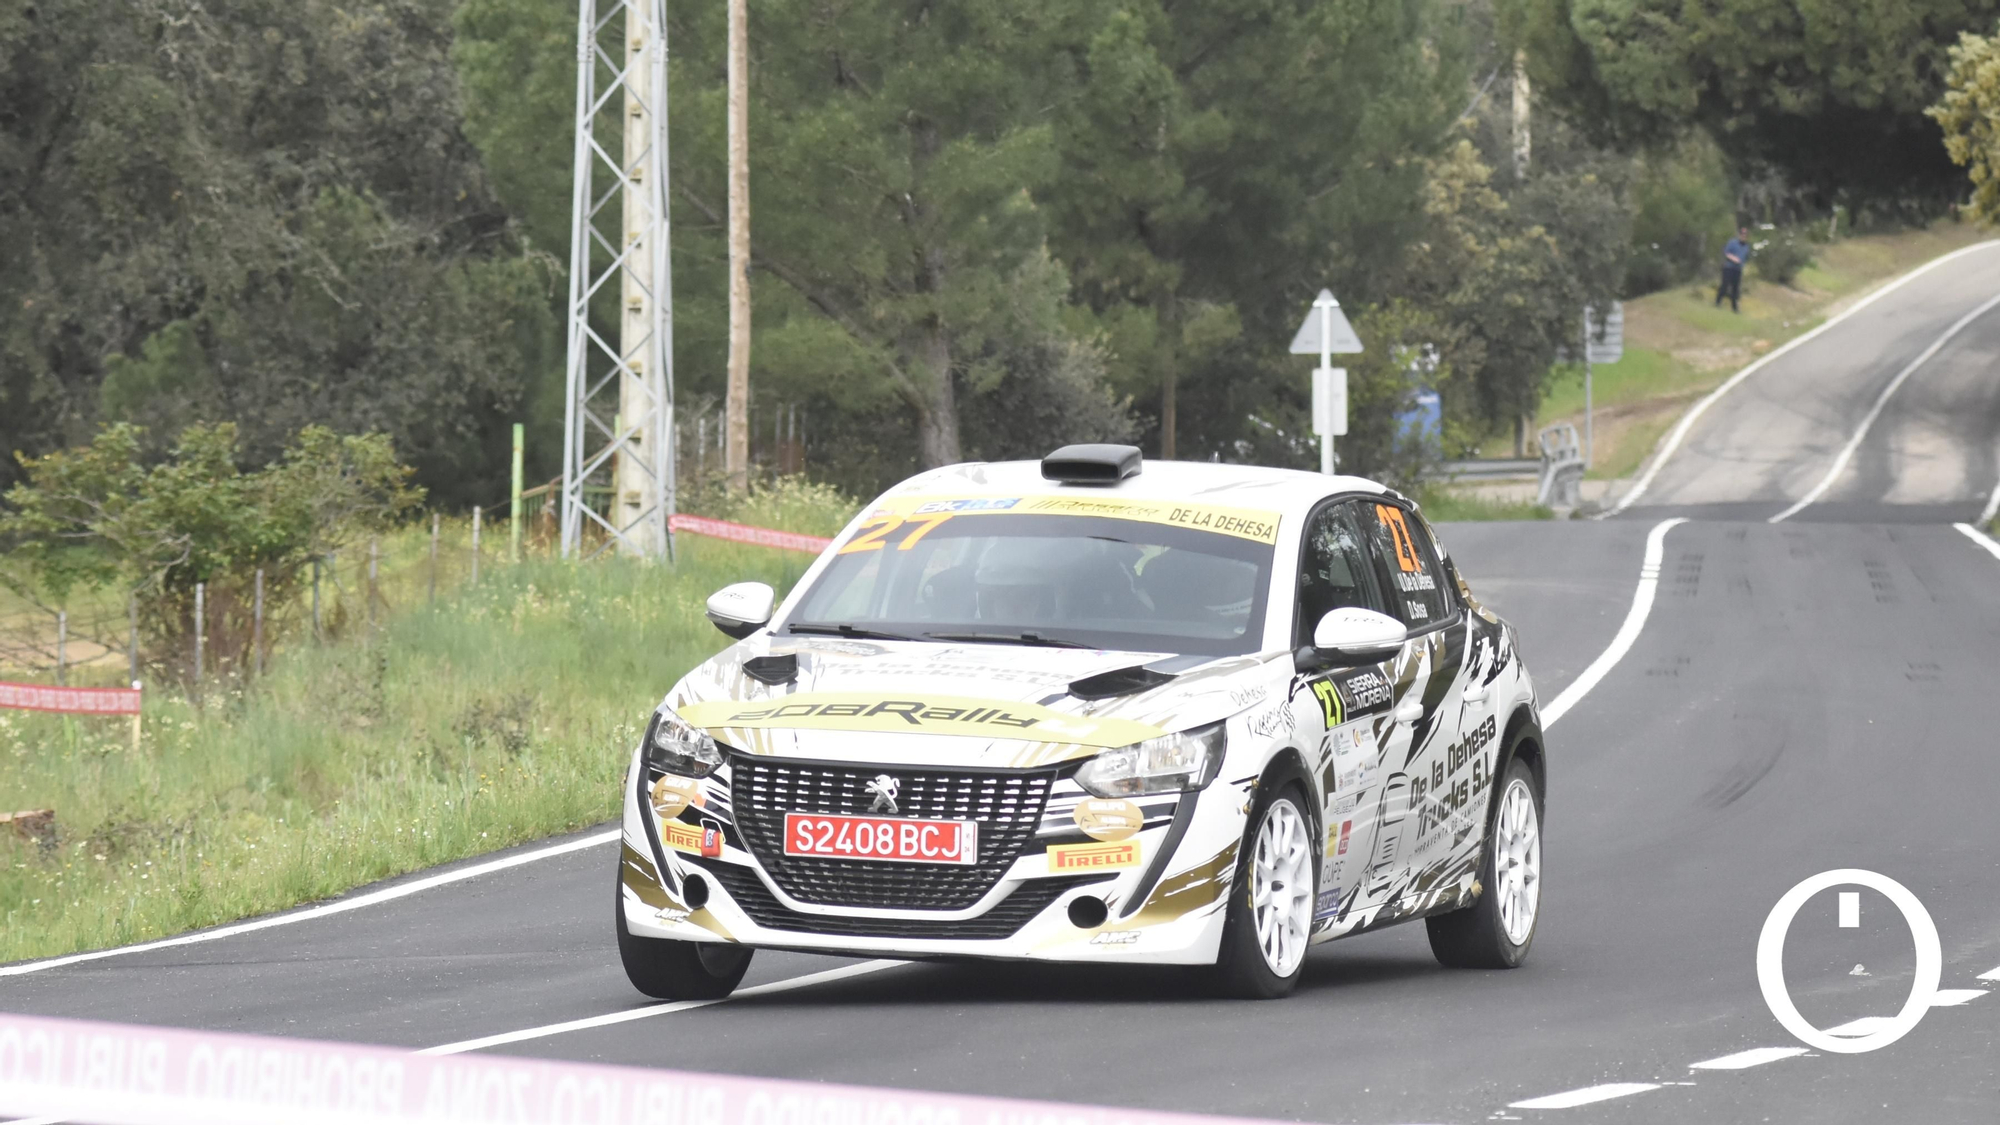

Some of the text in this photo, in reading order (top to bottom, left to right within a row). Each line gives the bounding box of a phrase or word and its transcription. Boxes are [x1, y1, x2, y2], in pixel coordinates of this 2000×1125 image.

[838, 512, 955, 555] 27
[1169, 508, 1274, 540] DE LA DEHESA
[1375, 504, 1421, 574] 27
[1346, 672, 1380, 694] SIERRA
[1354, 685, 1391, 710] MORENA
[727, 700, 1040, 729] 208Rally
[1313, 680, 1341, 728] 27
[1409, 713, 1497, 812] De la Dehesa
[1416, 777, 1469, 841] Trucks
[666, 824, 703, 850] PIREL
[796, 819, 961, 858] S2408 BCJ
[1056, 844, 1133, 868] PIRELLI
